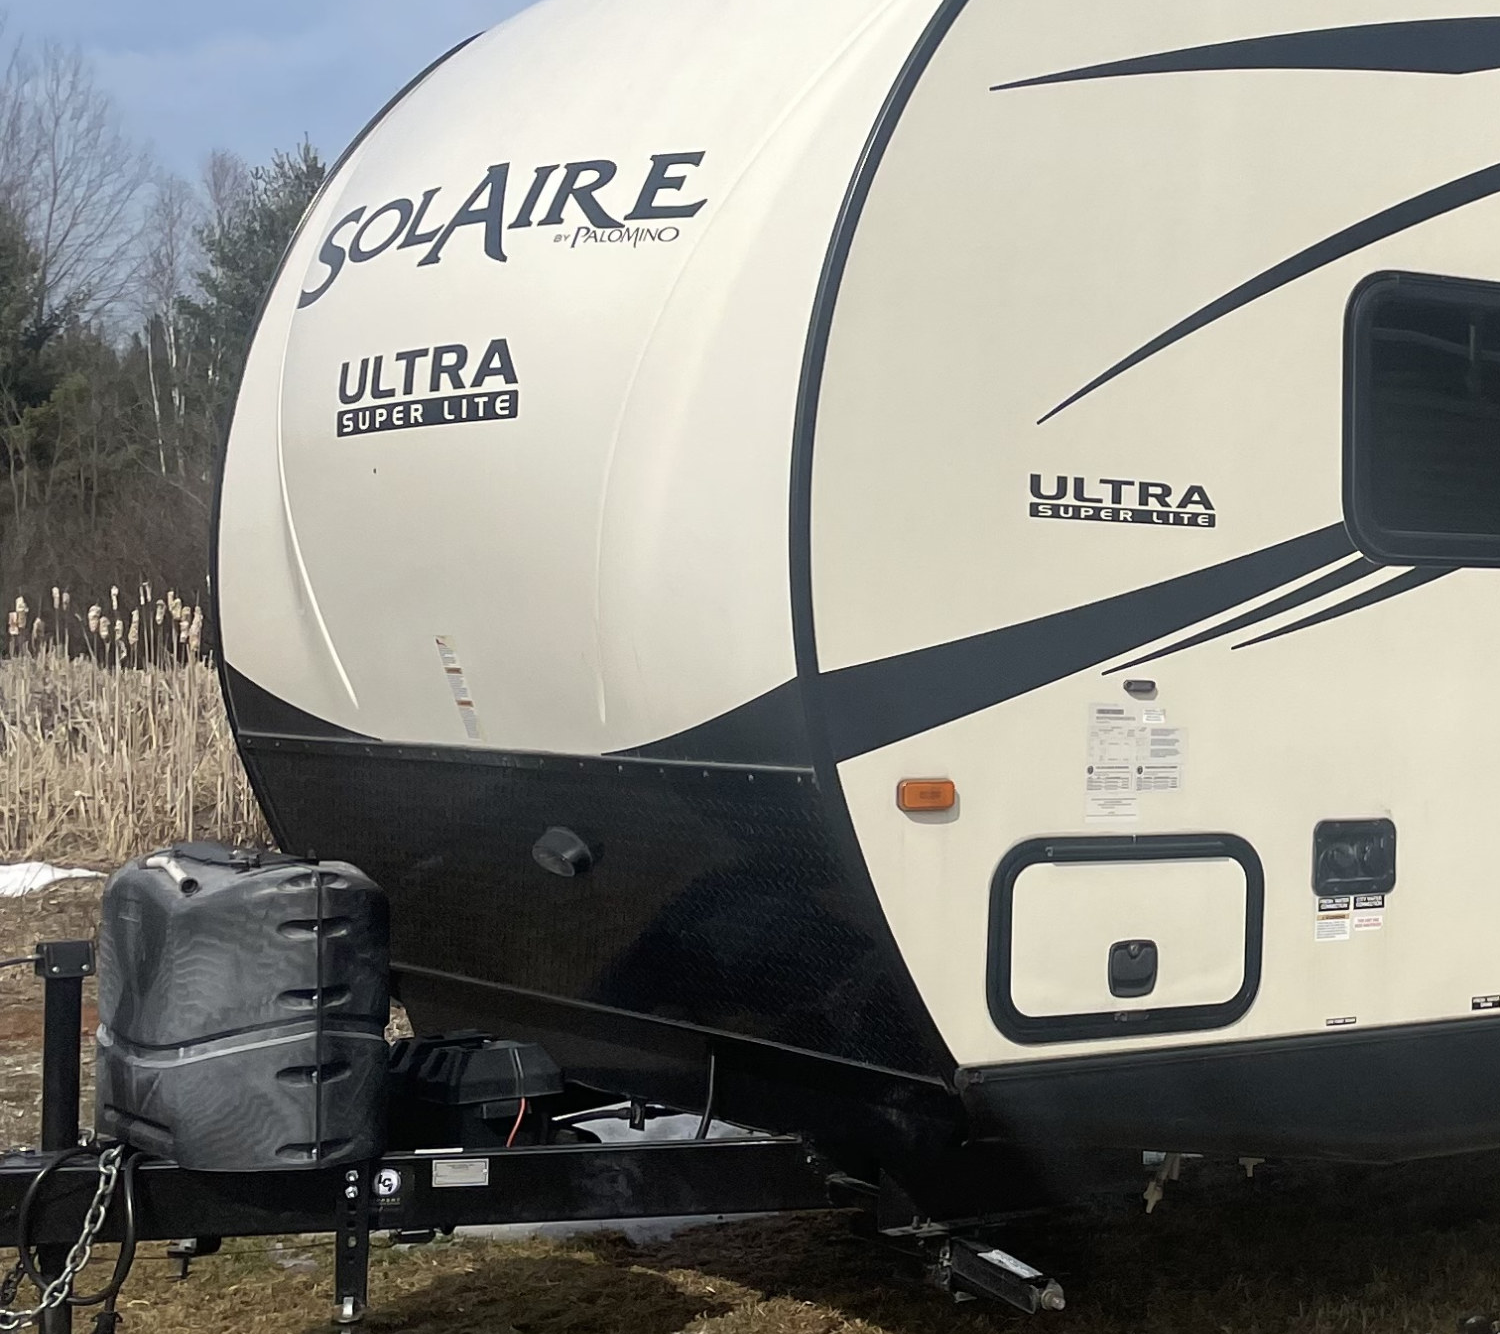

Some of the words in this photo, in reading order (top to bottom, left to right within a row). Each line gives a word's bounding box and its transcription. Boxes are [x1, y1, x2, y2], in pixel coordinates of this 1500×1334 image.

[297, 151, 708, 309] SOLAIRE
[553, 233, 570, 244] BY
[570, 226, 680, 249] PALOMINO
[338, 338, 519, 405] ULTRA
[342, 404, 424, 433] SUPER
[444, 394, 511, 421] LITE
[1030, 473, 1215, 511] ULTRA
[1038, 504, 1133, 522] SUPER
[1152, 511, 1210, 526] LITE
